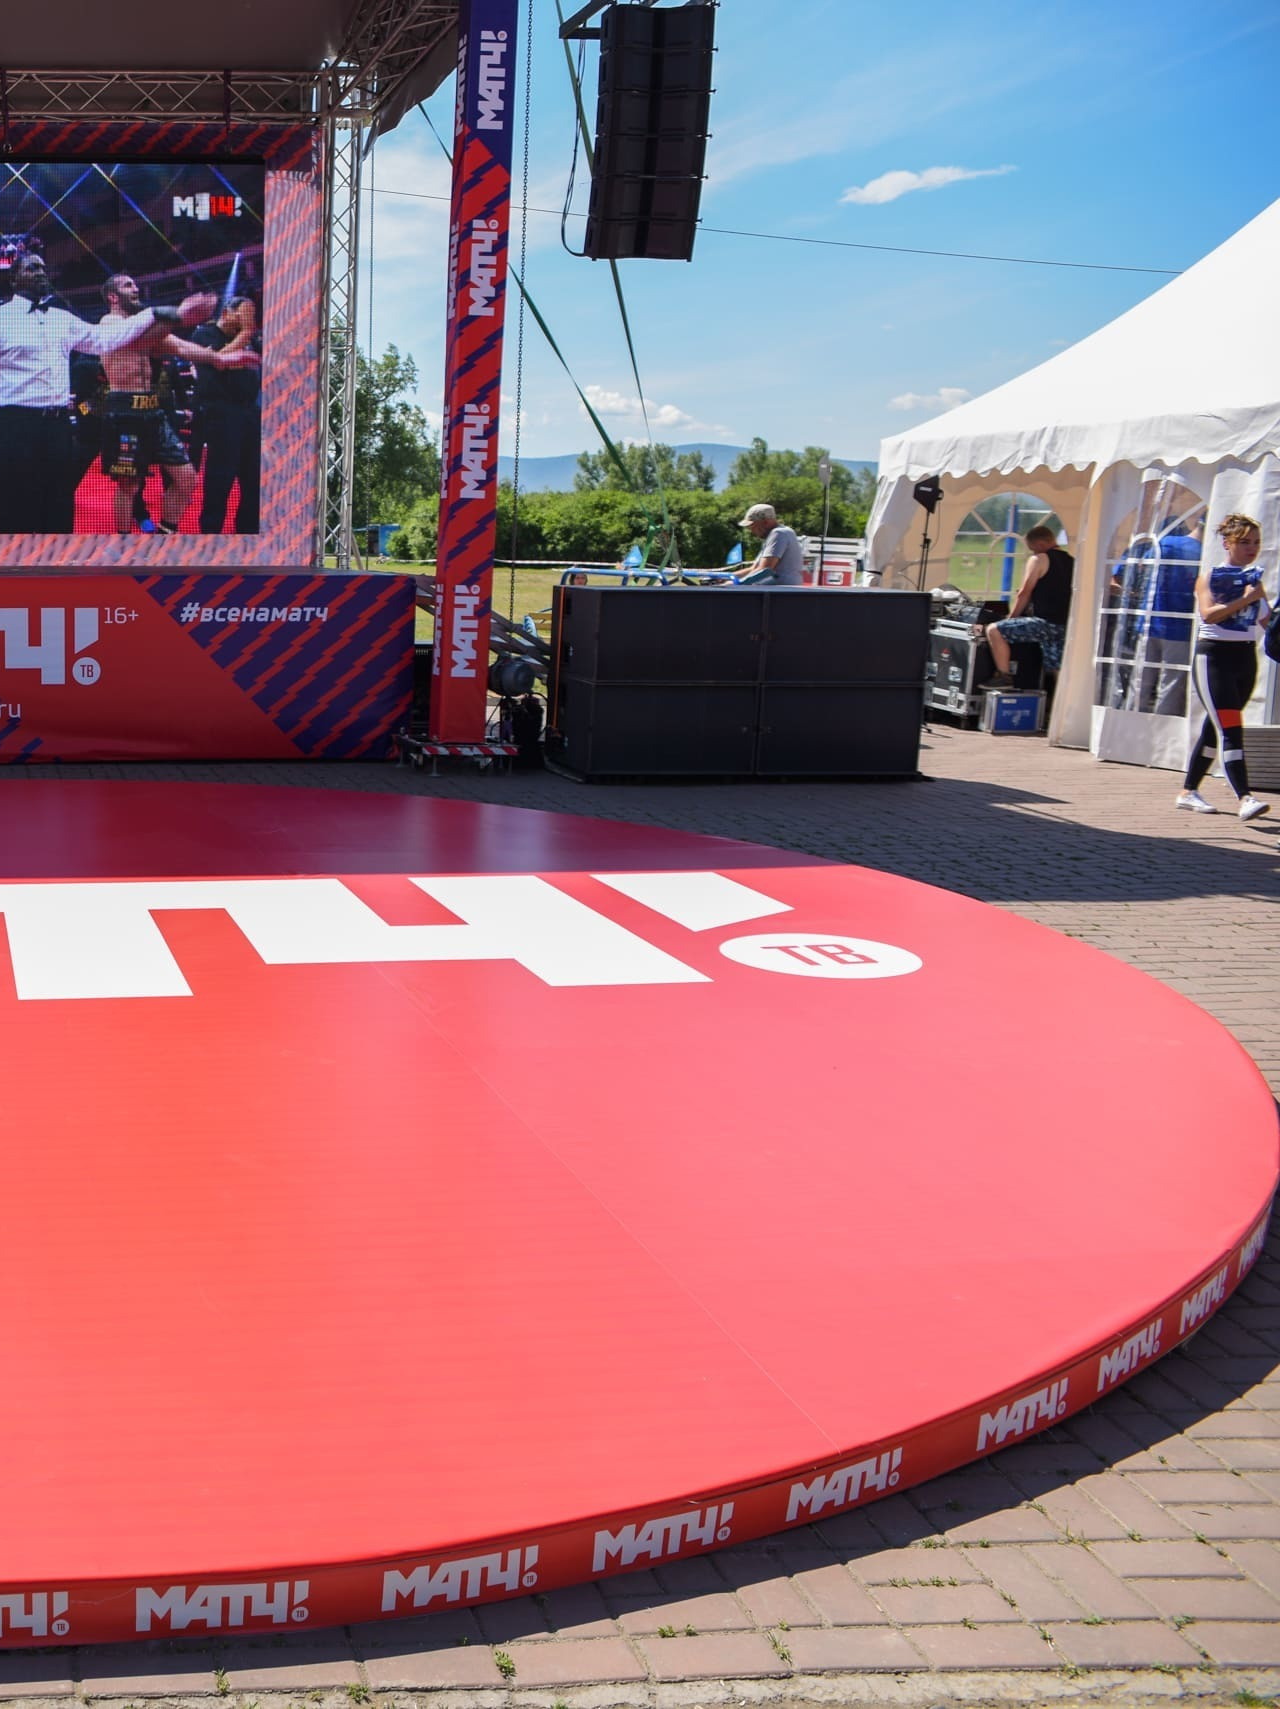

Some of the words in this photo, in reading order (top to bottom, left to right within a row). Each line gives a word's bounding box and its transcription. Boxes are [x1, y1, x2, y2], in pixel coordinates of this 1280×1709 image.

[477, 30, 508, 130] МАТЧ!
[469, 219, 499, 316] МАТЧ!
[460, 403, 490, 499] МАТЧ!
[104, 607, 139, 624] 16+
[451, 584, 481, 678] МАТЧ!
[79, 664, 94, 678] ТВ
[760, 944, 879, 966] ТВ
[1097, 1318, 1162, 1393] МАТЧ!
[976, 1377, 1068, 1451] МАТЧ!
[785, 1447, 903, 1522] МАТЧ!
[592, 1502, 734, 1572] МАТЧ!
[135, 1579, 310, 1632] МАТЧ!
[381, 1544, 539, 1612] МАТЧ!
